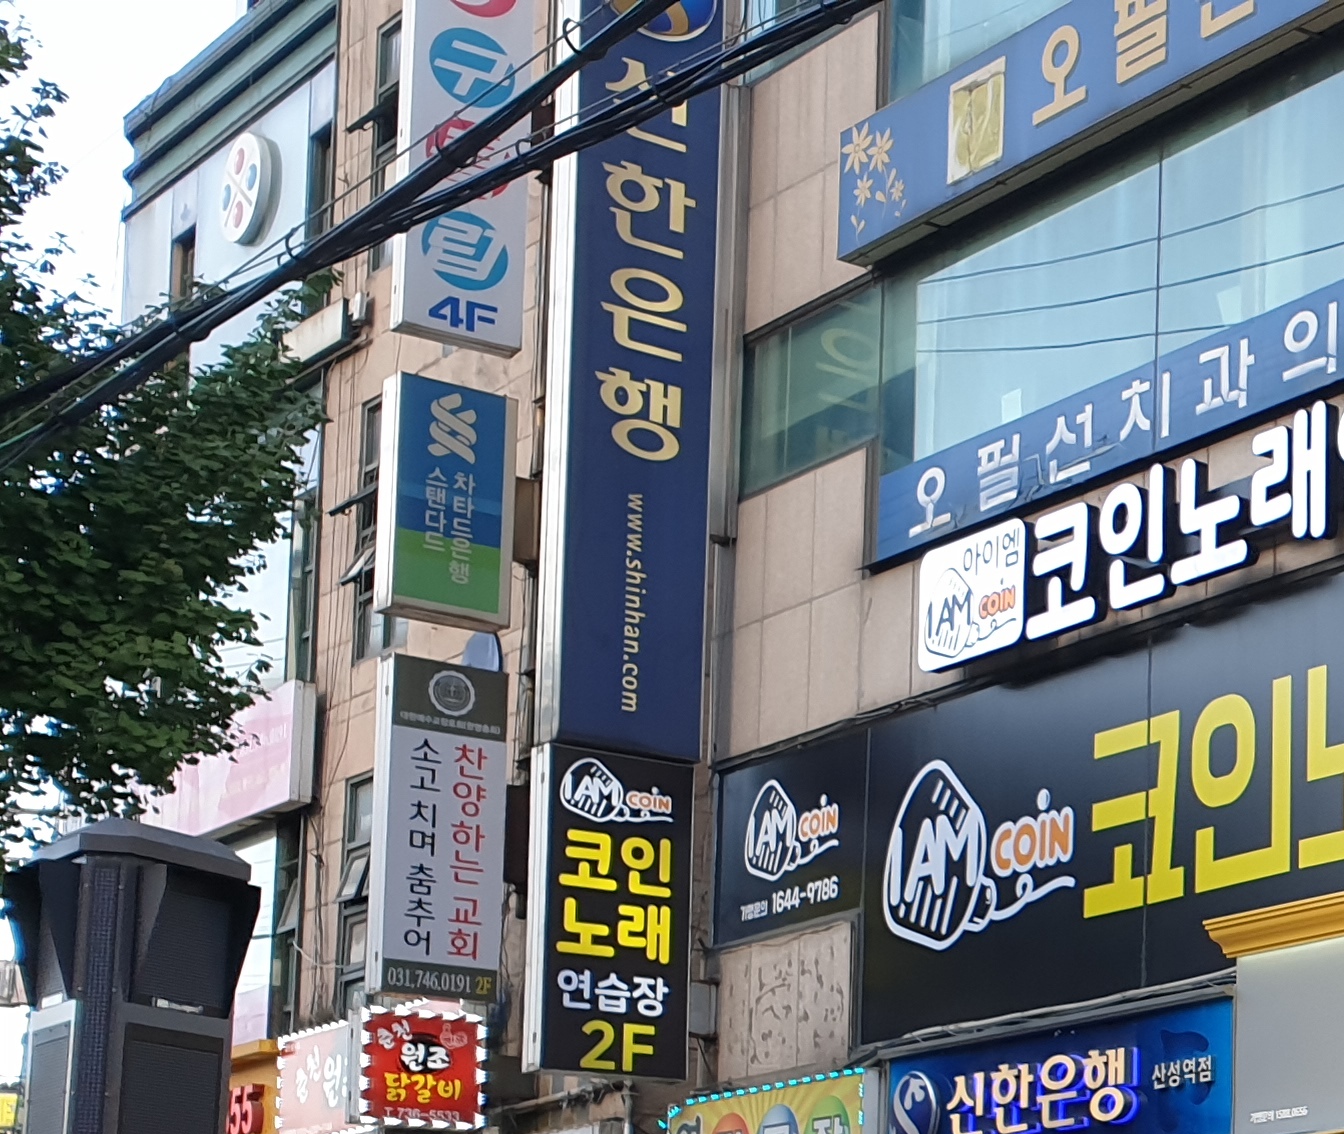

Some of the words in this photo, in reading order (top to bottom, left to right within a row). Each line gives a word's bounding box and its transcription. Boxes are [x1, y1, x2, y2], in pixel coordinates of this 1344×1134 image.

[595, 57, 696, 461] 신한은행
[427, 296, 498, 332] 4F
[423, 466, 449, 552] 스탠다드
[449, 472, 476, 585] 차타드은행
[963, 527, 1021, 573] 아이엠
[620, 493, 643, 712] www.shinhan.com
[410, 738, 442, 793] 소고
[409, 800, 437, 858] 치며
[450, 743, 487, 886] 찬양하는
[558, 828, 672, 898] 코인
[404, 863, 437, 956] 춤추어
[772, 875, 839, 915] 1644-9786
[447, 896, 483, 962] 교회
[556, 896, 671, 965] 노래
[387, 966, 472, 996] 031.746.0191
[475, 976, 493, 996] 2F
[557, 968, 670, 1018] 연습장
[400, 1042, 451, 1073] 원조
[579, 1019, 657, 1073] 2F
[1151, 1056, 1213, 1090] 산성역점
[384, 1072, 461, 1105] 닭갈비
